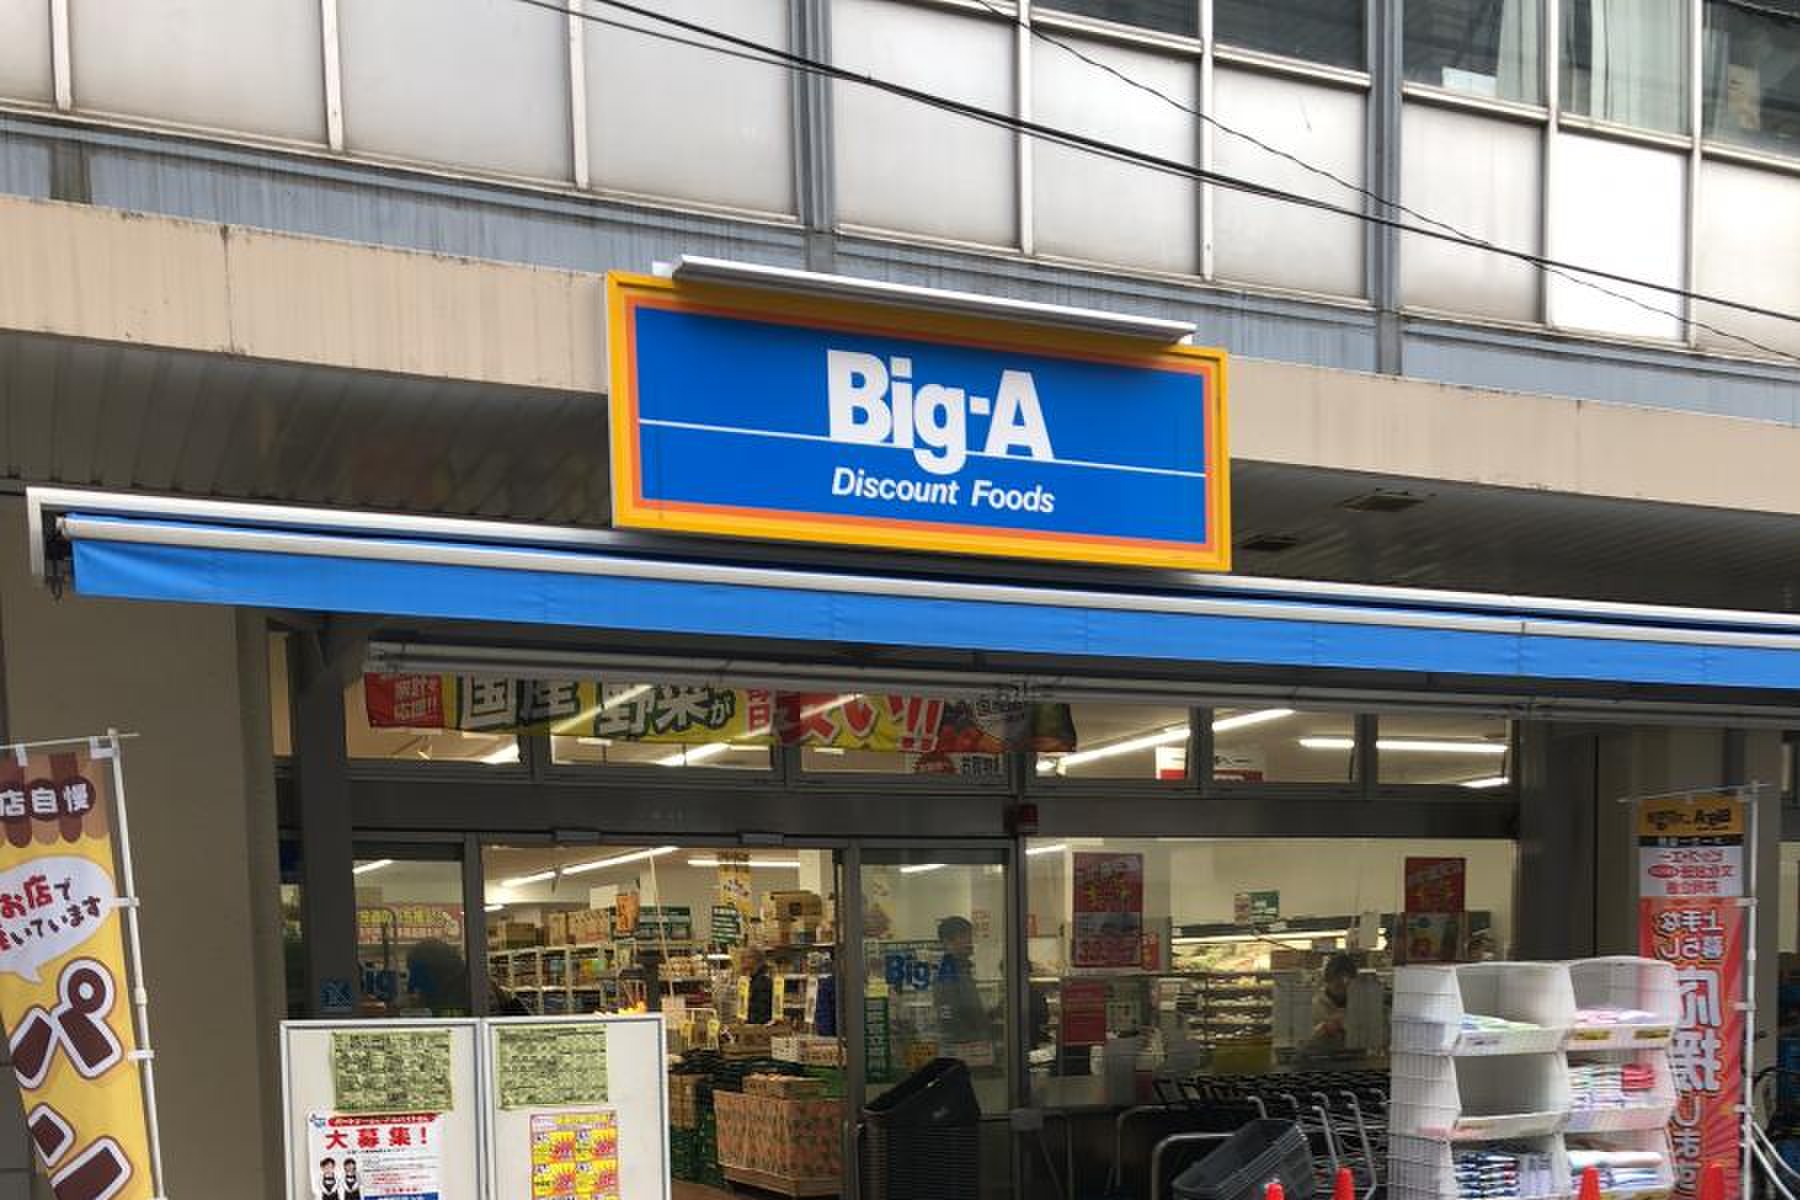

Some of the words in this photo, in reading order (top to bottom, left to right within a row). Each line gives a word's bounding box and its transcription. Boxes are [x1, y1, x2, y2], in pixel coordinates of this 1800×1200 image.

[827, 349, 1055, 475] Big-A
[831, 467, 960, 506] Discount
[971, 479, 1055, 514] Foods
[0, 875, 72, 919] お店で
